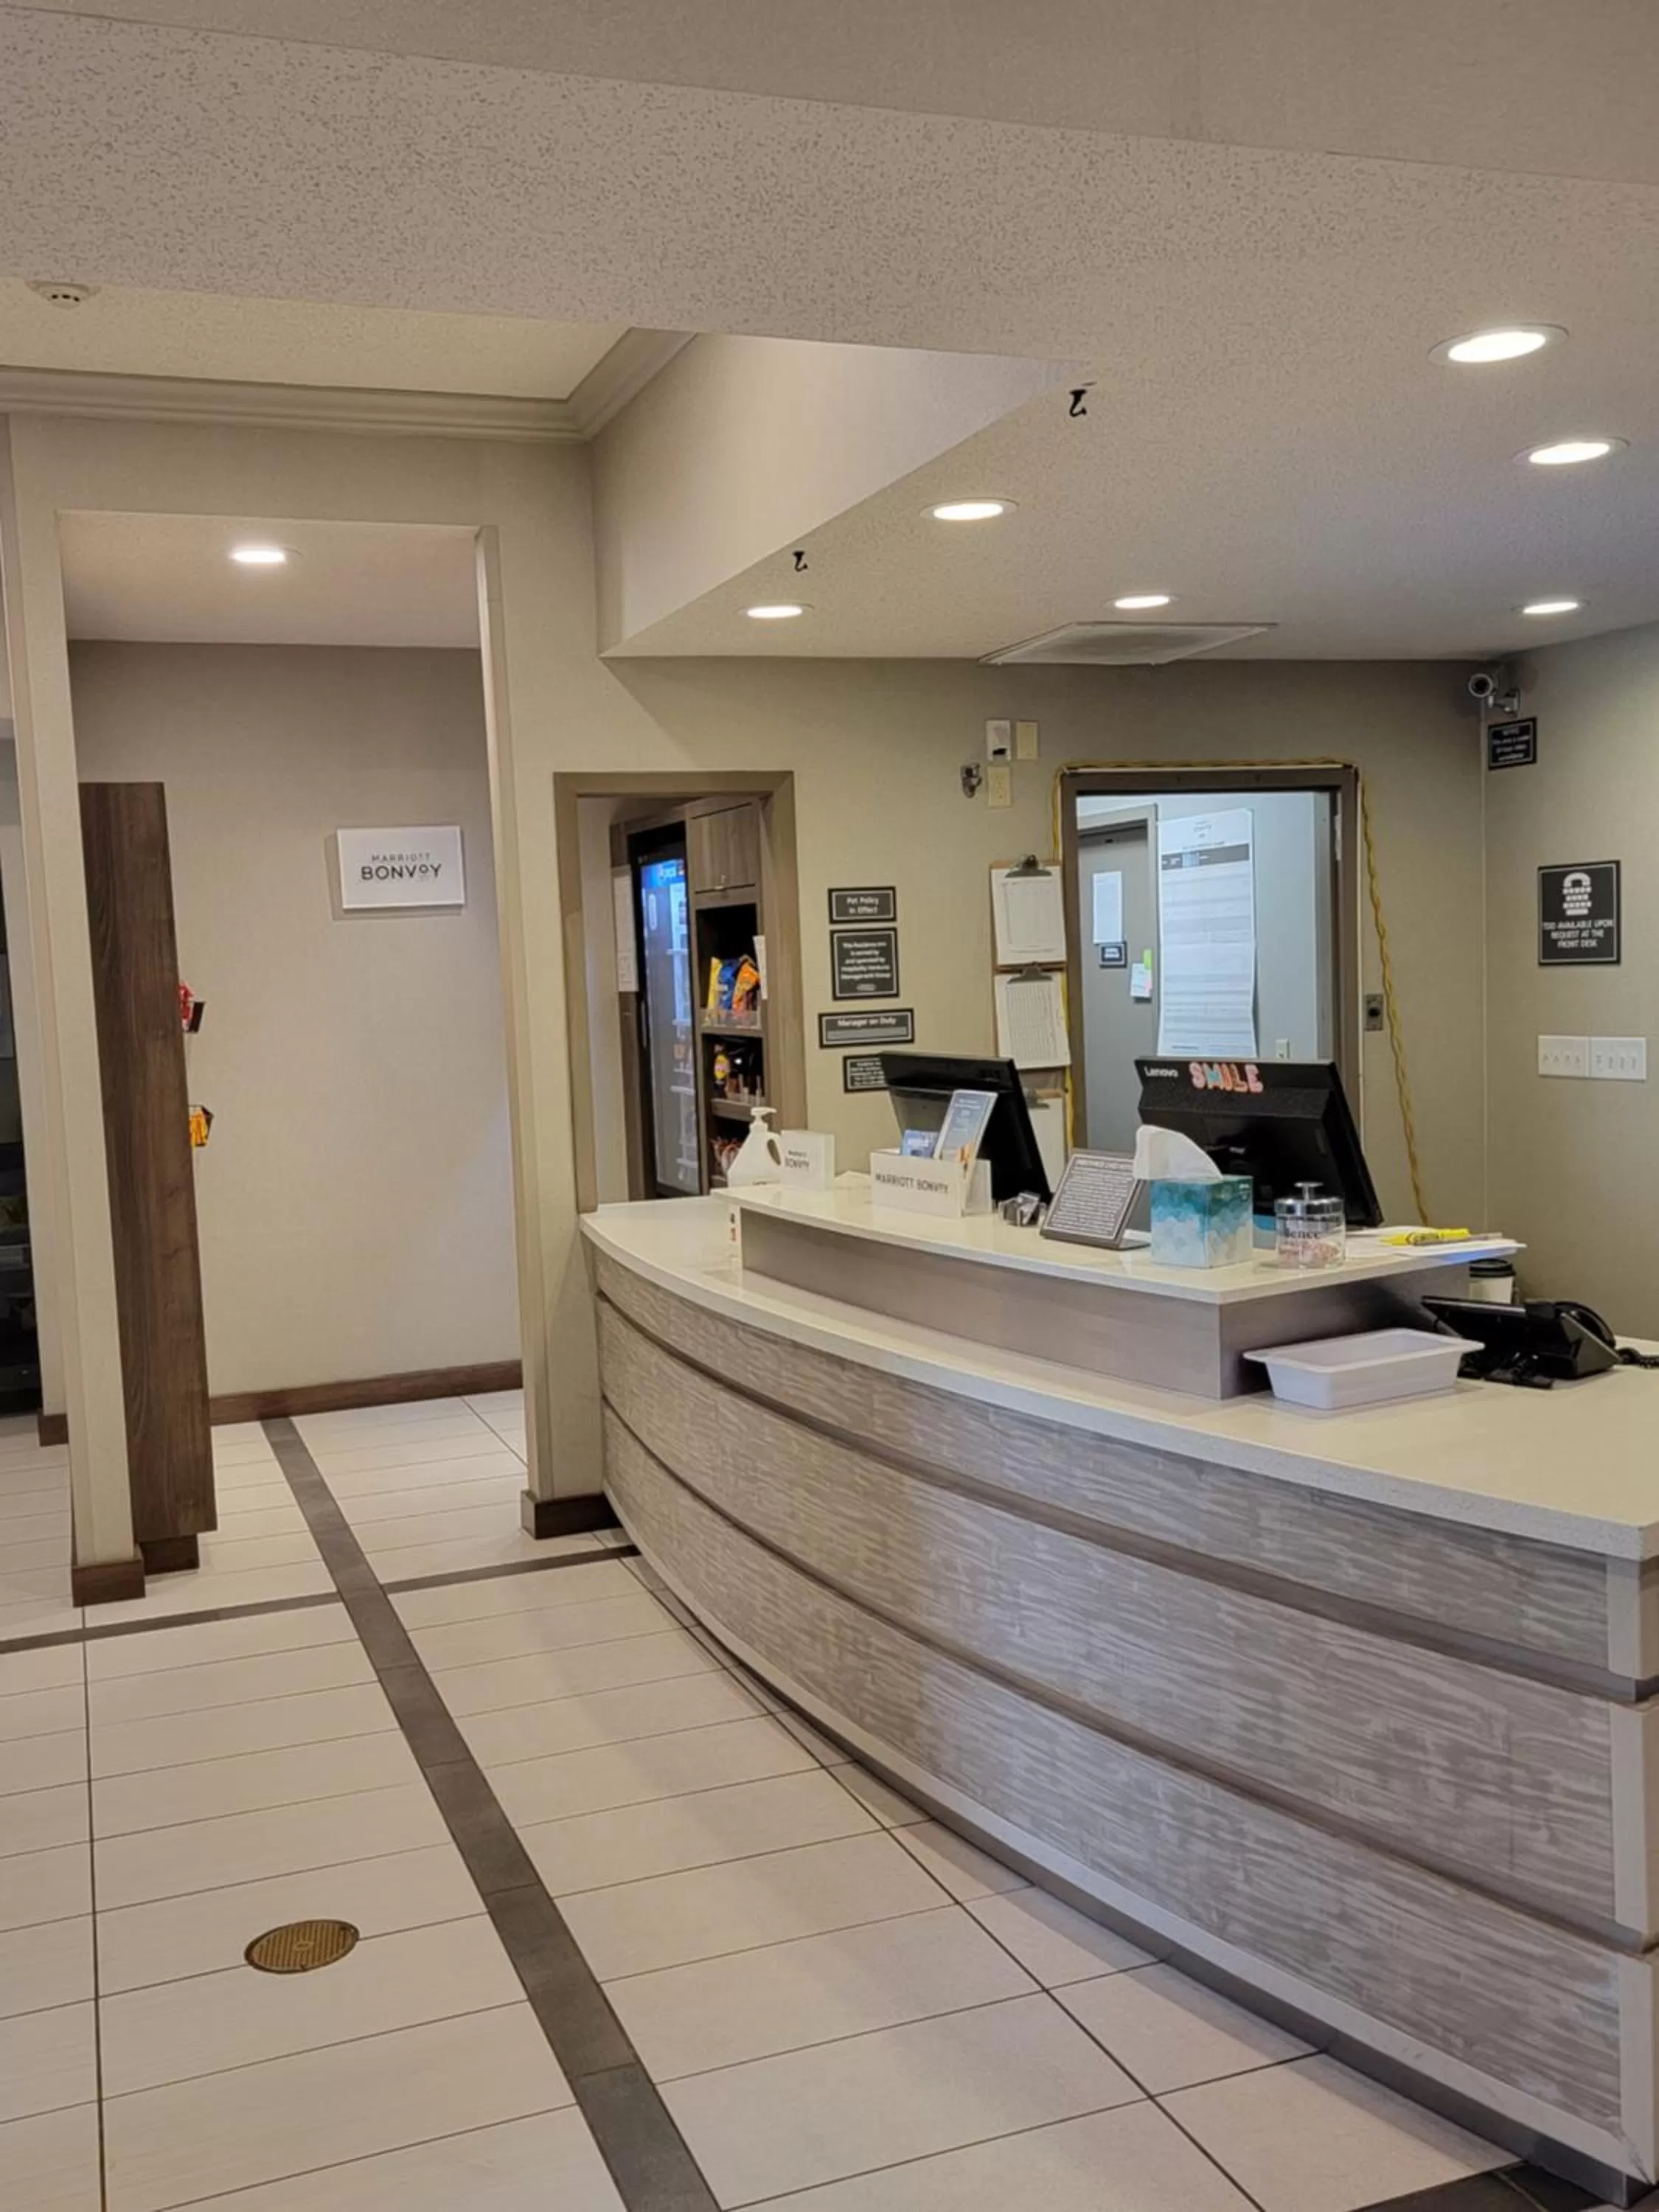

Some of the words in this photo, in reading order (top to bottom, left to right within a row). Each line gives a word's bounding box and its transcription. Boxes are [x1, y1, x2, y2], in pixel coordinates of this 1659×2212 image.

[371, 853, 431, 862] MARRIOTT
[361, 863, 442, 880] BONVOY
[860, 896, 879, 905] Policy
[1557, 920, 1592, 929] AVAILABLE
[1593, 919, 1613, 928] UPON
[1551, 931, 1579, 939] REQUEST
[1581, 930, 1590, 938] AT
[1591, 929, 1604, 938] THE
[1557, 939, 1579, 948] FRONT
[1580, 939, 1597, 947] DESK
[838, 1018, 867, 1027] Manager
[880, 1017, 897, 1025] Duty
[1144, 1066, 1179, 1077] Lenovo
[1189, 1062, 1263, 1092] SMILE
[875, 1173, 914, 1189] MARRIOTT
